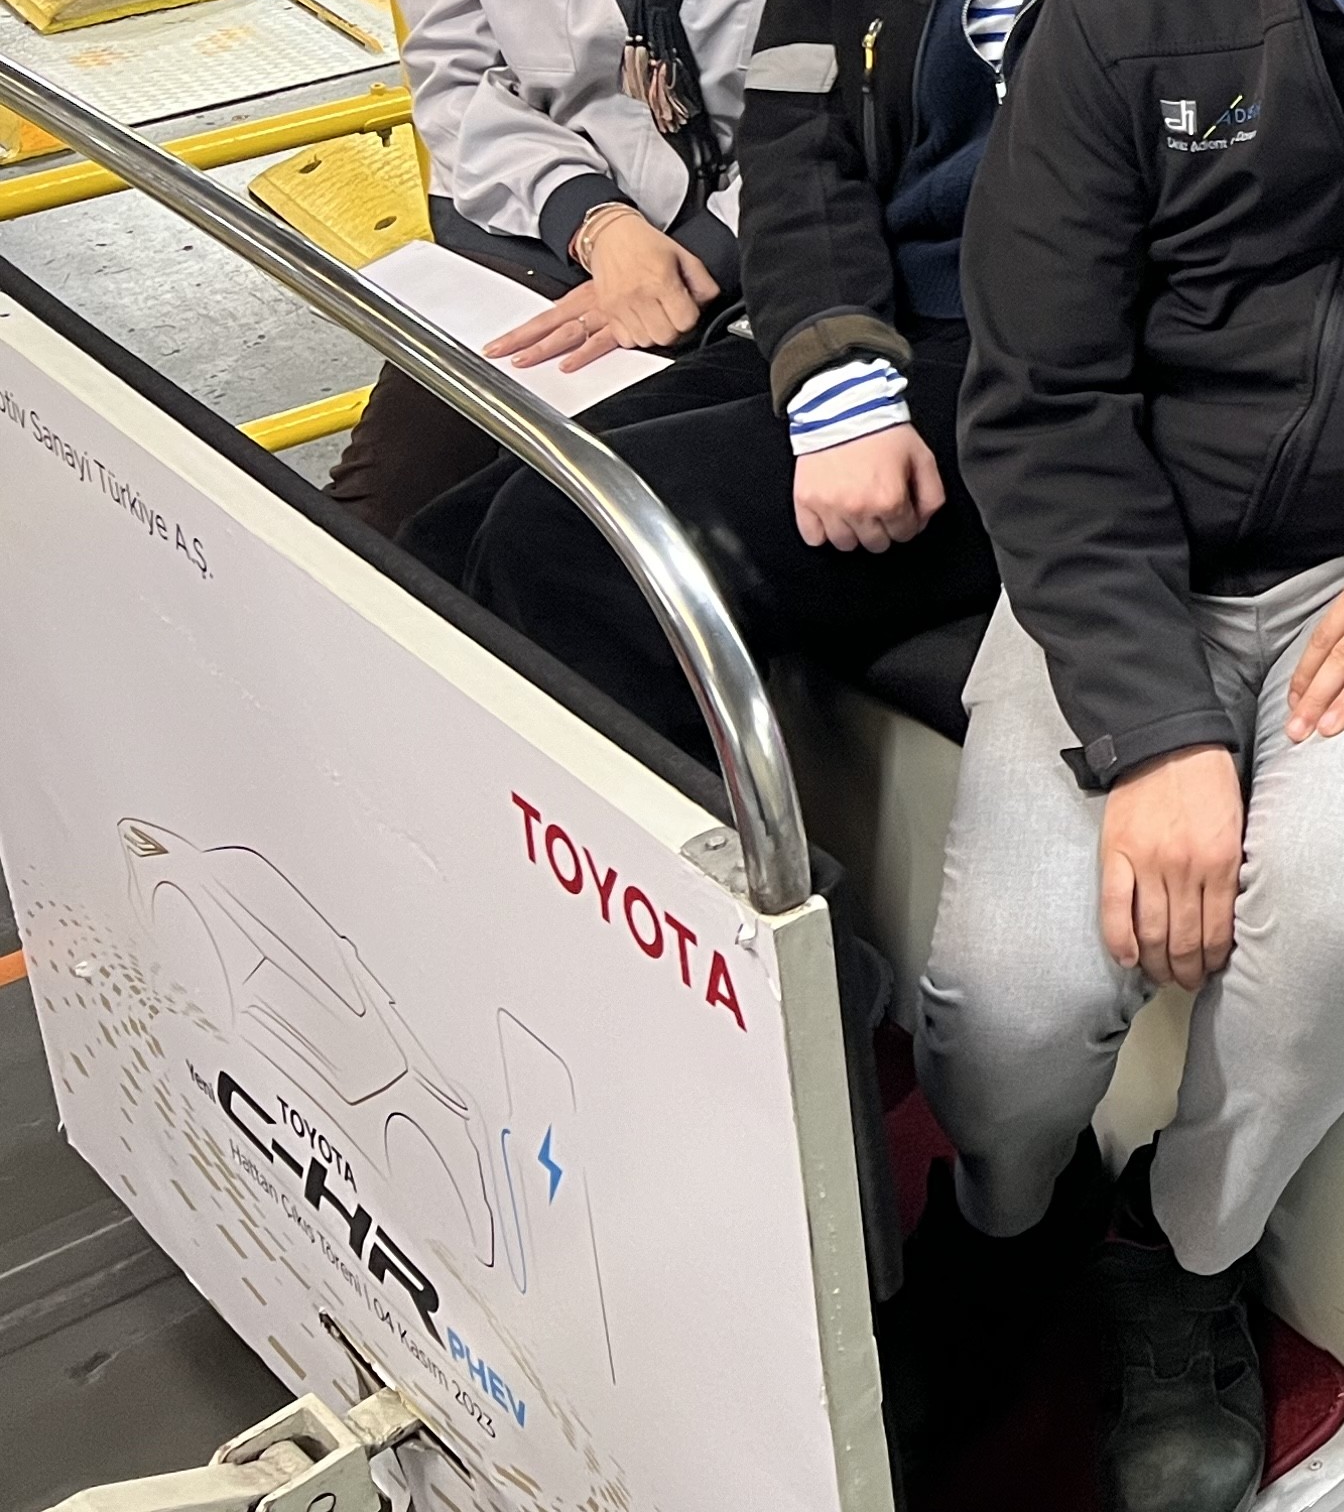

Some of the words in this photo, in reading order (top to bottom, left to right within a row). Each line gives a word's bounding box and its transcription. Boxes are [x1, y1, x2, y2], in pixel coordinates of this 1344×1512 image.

[29, 410, 93, 483] Sanayi
[93, 458, 169, 541] Türkiye
[511, 790, 747, 1034] TOYOTA
[185, 1058, 217, 1105] Yeni
[217, 1070, 447, 1350] C-HR
[447, 1326, 526, 1429] PHEV
[276, 1094, 358, 1193] TOYOTA
[229, 1138, 279, 1205] Hattan
[397, 1321, 449, 1392] Kasım
[451, 1379, 496, 1439] 2023
